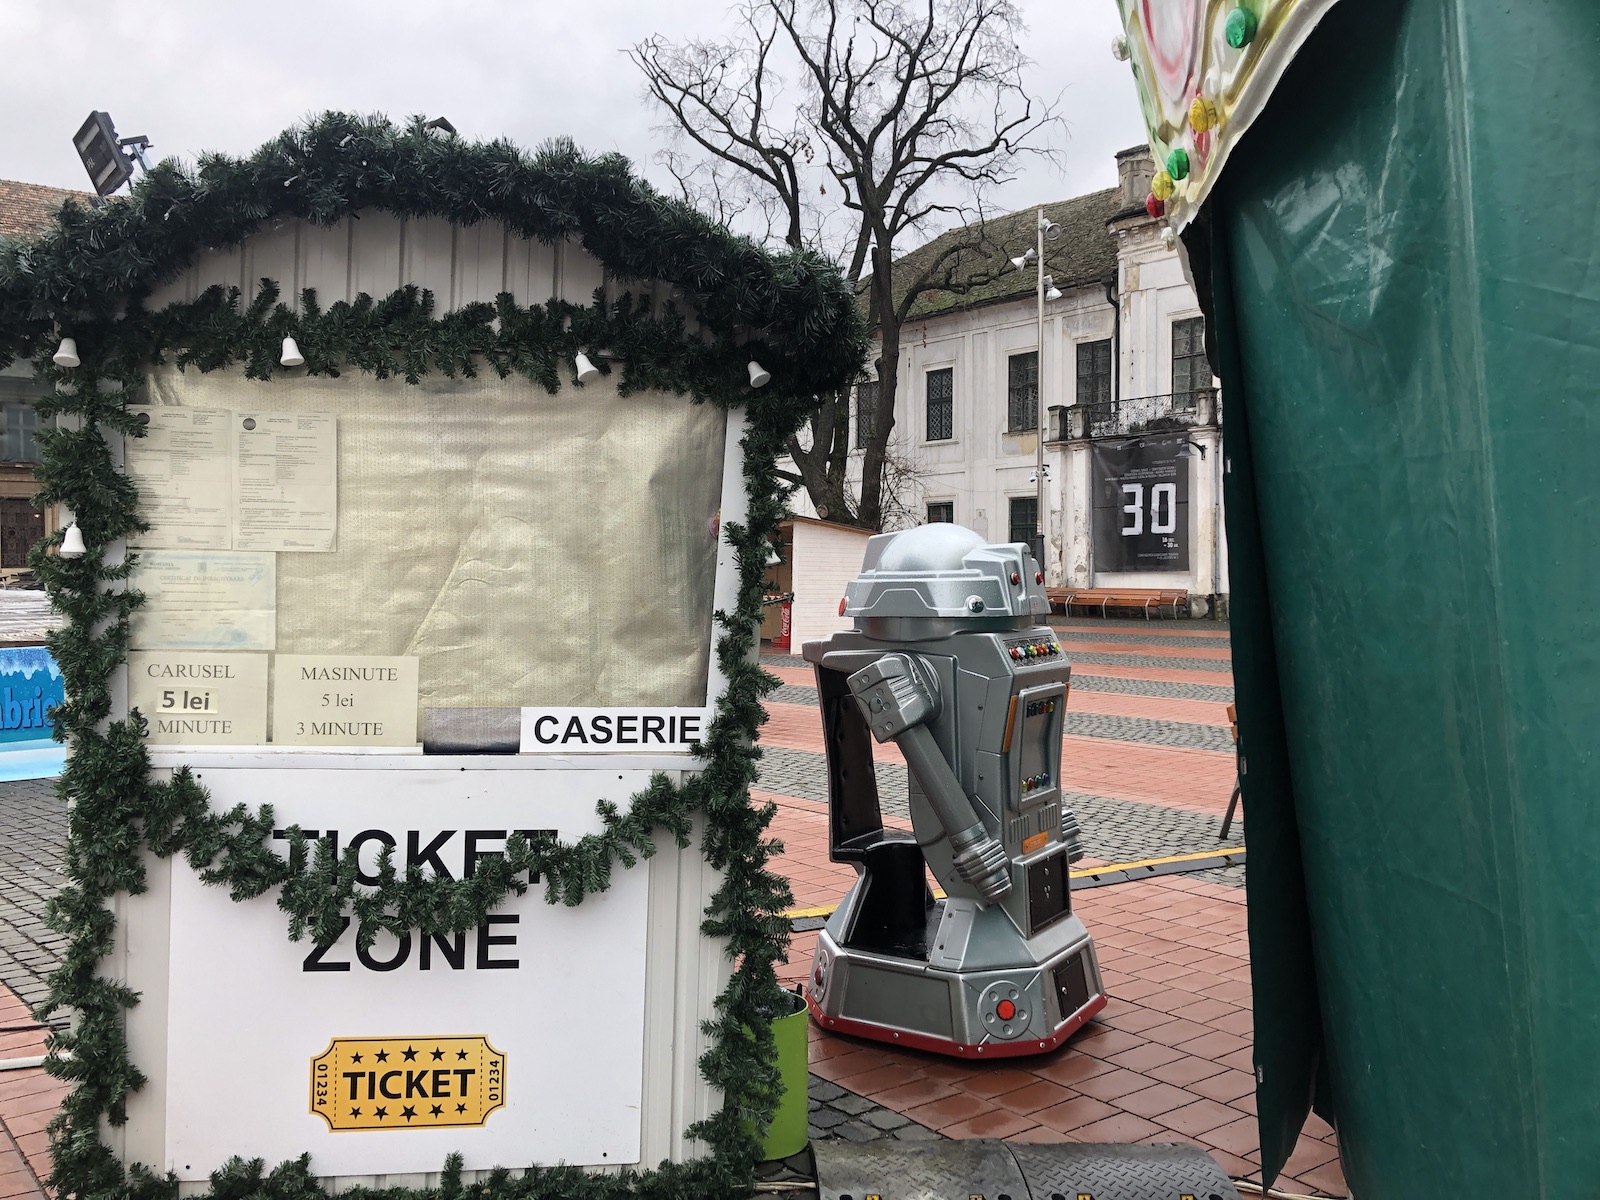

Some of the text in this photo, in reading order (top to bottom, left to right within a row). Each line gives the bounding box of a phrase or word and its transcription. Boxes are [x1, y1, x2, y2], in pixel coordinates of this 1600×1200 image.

[1121, 482, 1176, 536] 30
[147, 663, 235, 679] CARUSEL
[300, 666, 398, 681] MASINUTE
[162, 690, 210, 711] 5 lei
[321, 693, 354, 708] 5 lei
[157, 720, 232, 734] MINUTE
[296, 721, 383, 736] 3 MINUTE
[534, 715, 701, 745] CASERIE
[302, 914, 520, 972] ZONE
[316, 1063, 328, 1106] 01234
[342, 1068, 476, 1100] TICKET
[488, 1060, 500, 1101] 01234
